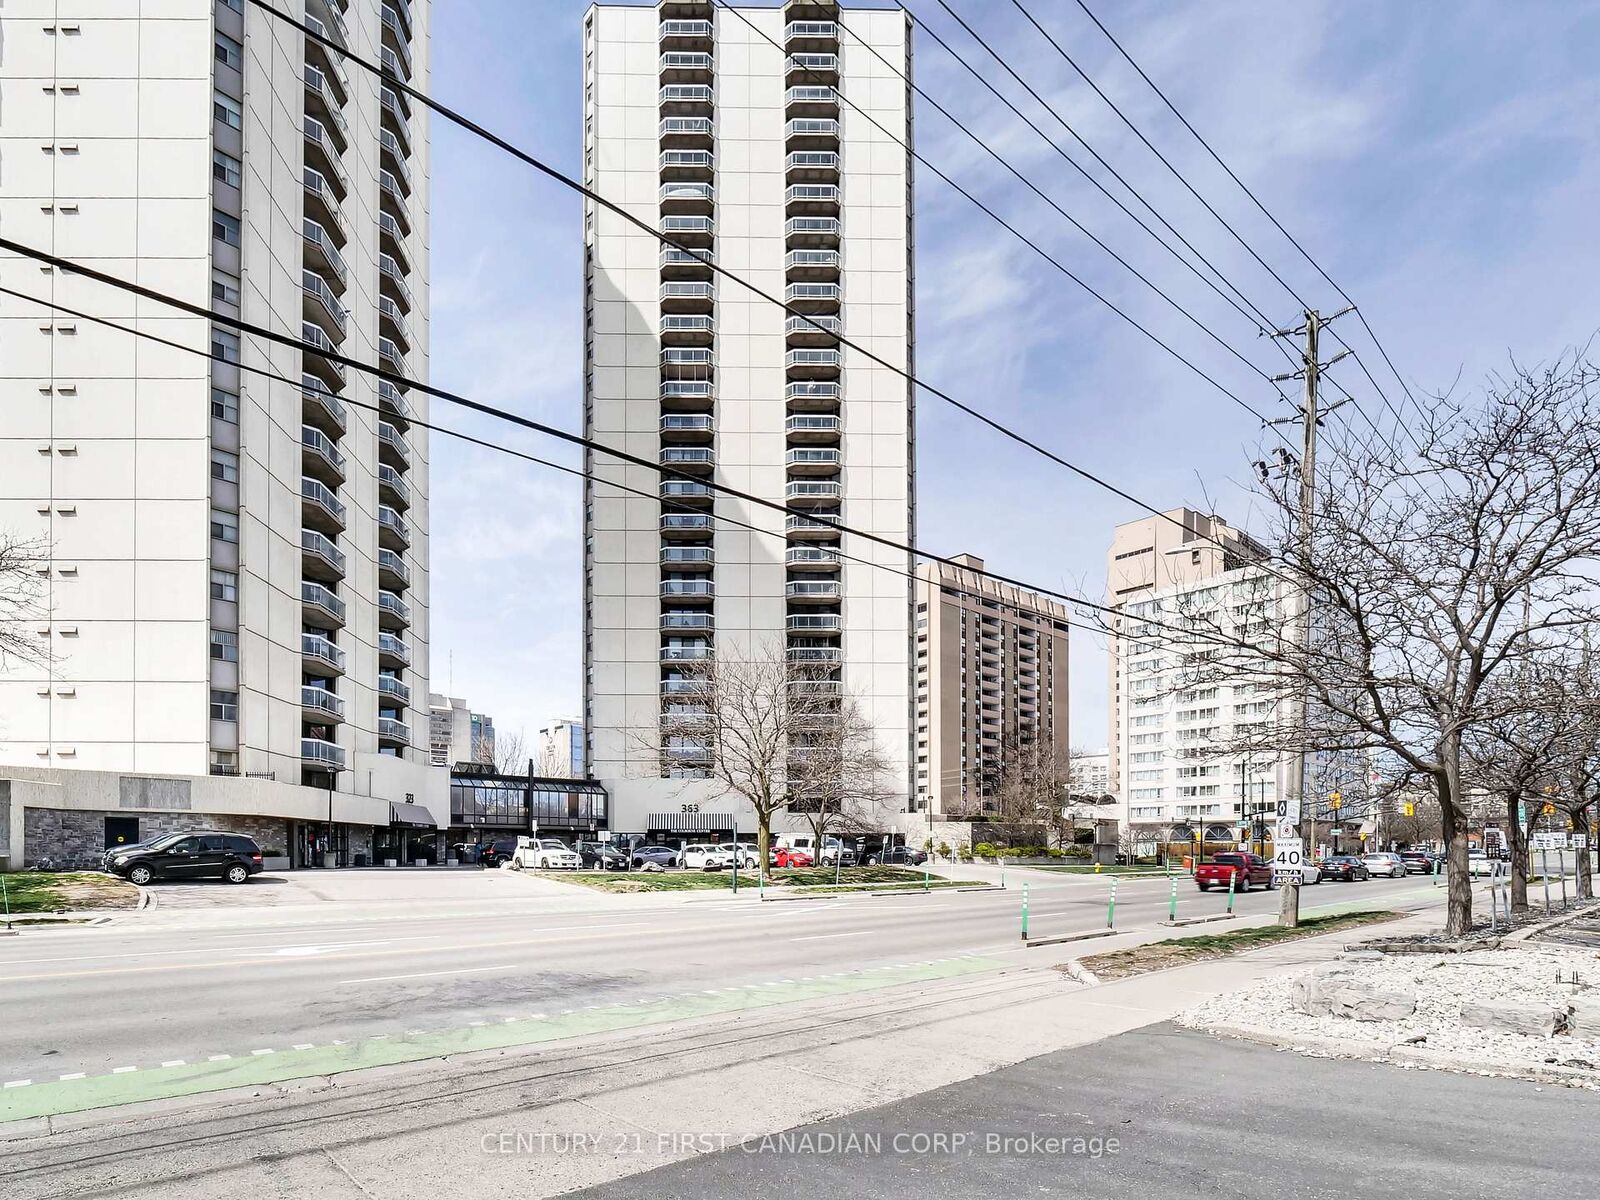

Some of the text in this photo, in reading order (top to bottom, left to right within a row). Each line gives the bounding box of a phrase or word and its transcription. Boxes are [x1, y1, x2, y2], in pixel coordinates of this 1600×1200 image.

[681, 804, 699, 813] 363
[1277, 851, 1300, 865] 40
[1276, 876, 1300, 884] AREA
